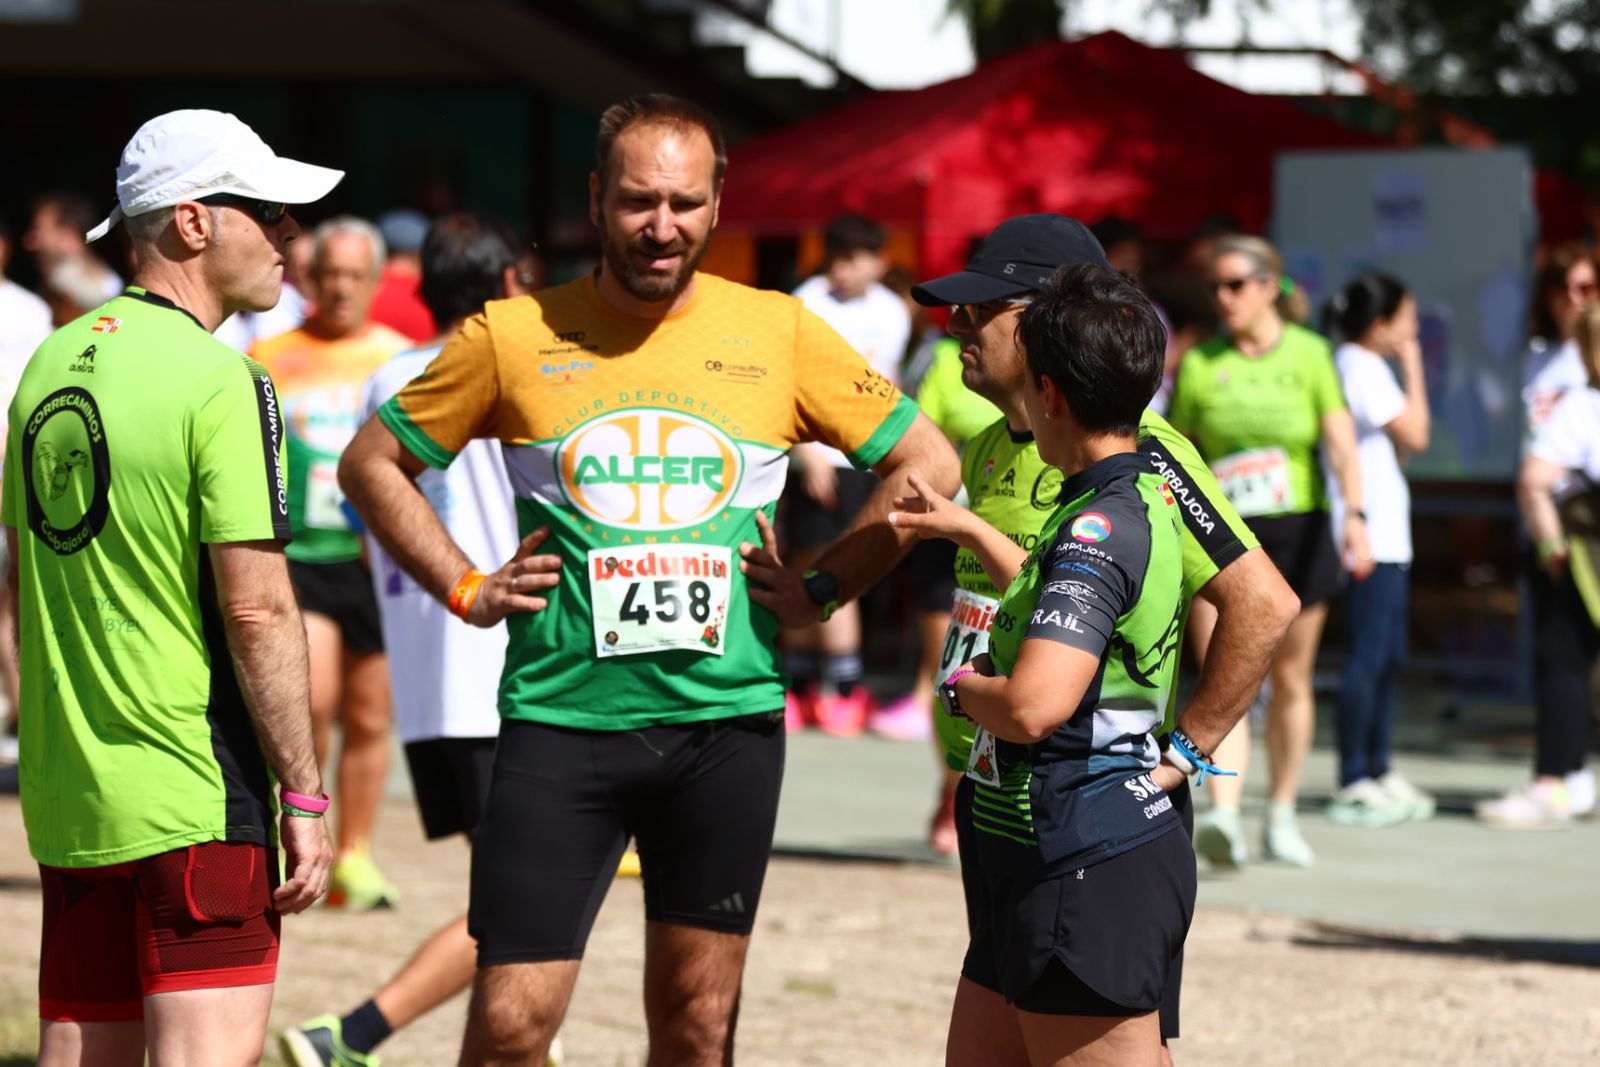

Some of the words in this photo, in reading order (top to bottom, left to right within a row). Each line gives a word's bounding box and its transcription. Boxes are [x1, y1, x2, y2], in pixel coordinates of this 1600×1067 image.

[29, 394, 102, 443] CORRECAMINOS
[552, 399, 605, 437] CLUB
[618, 390, 743, 437] DEPORTIVO
[573, 455, 724, 493] ALCER
[1150, 451, 1215, 535] CARBAJOSA
[619, 580, 711, 626] 458
